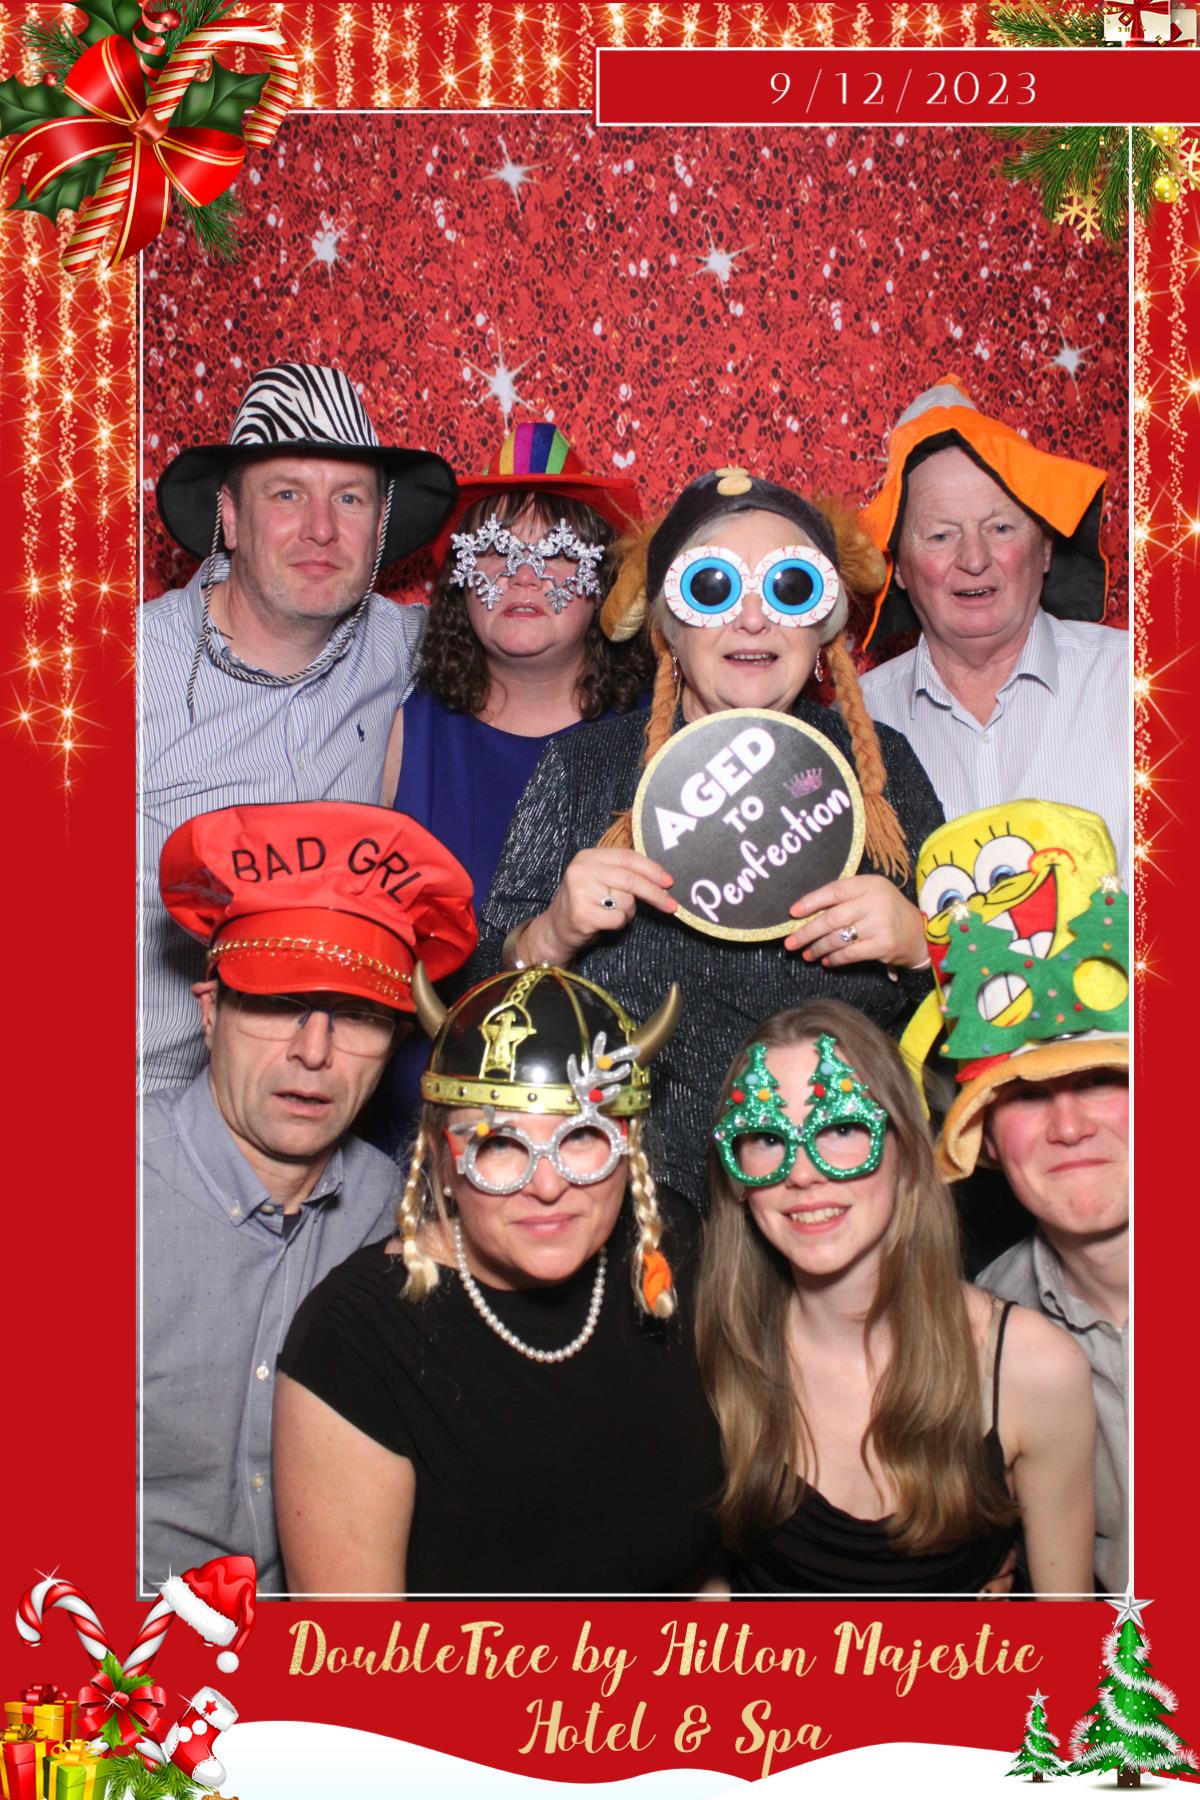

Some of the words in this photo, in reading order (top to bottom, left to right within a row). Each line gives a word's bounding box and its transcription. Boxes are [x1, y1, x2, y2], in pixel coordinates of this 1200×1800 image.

[654, 728, 775, 850] AGED
[723, 796, 763, 832] TO
[231, 837, 326, 882] BAD
[348, 838, 421, 904] GRL
[691, 789, 850, 922] Perfection
